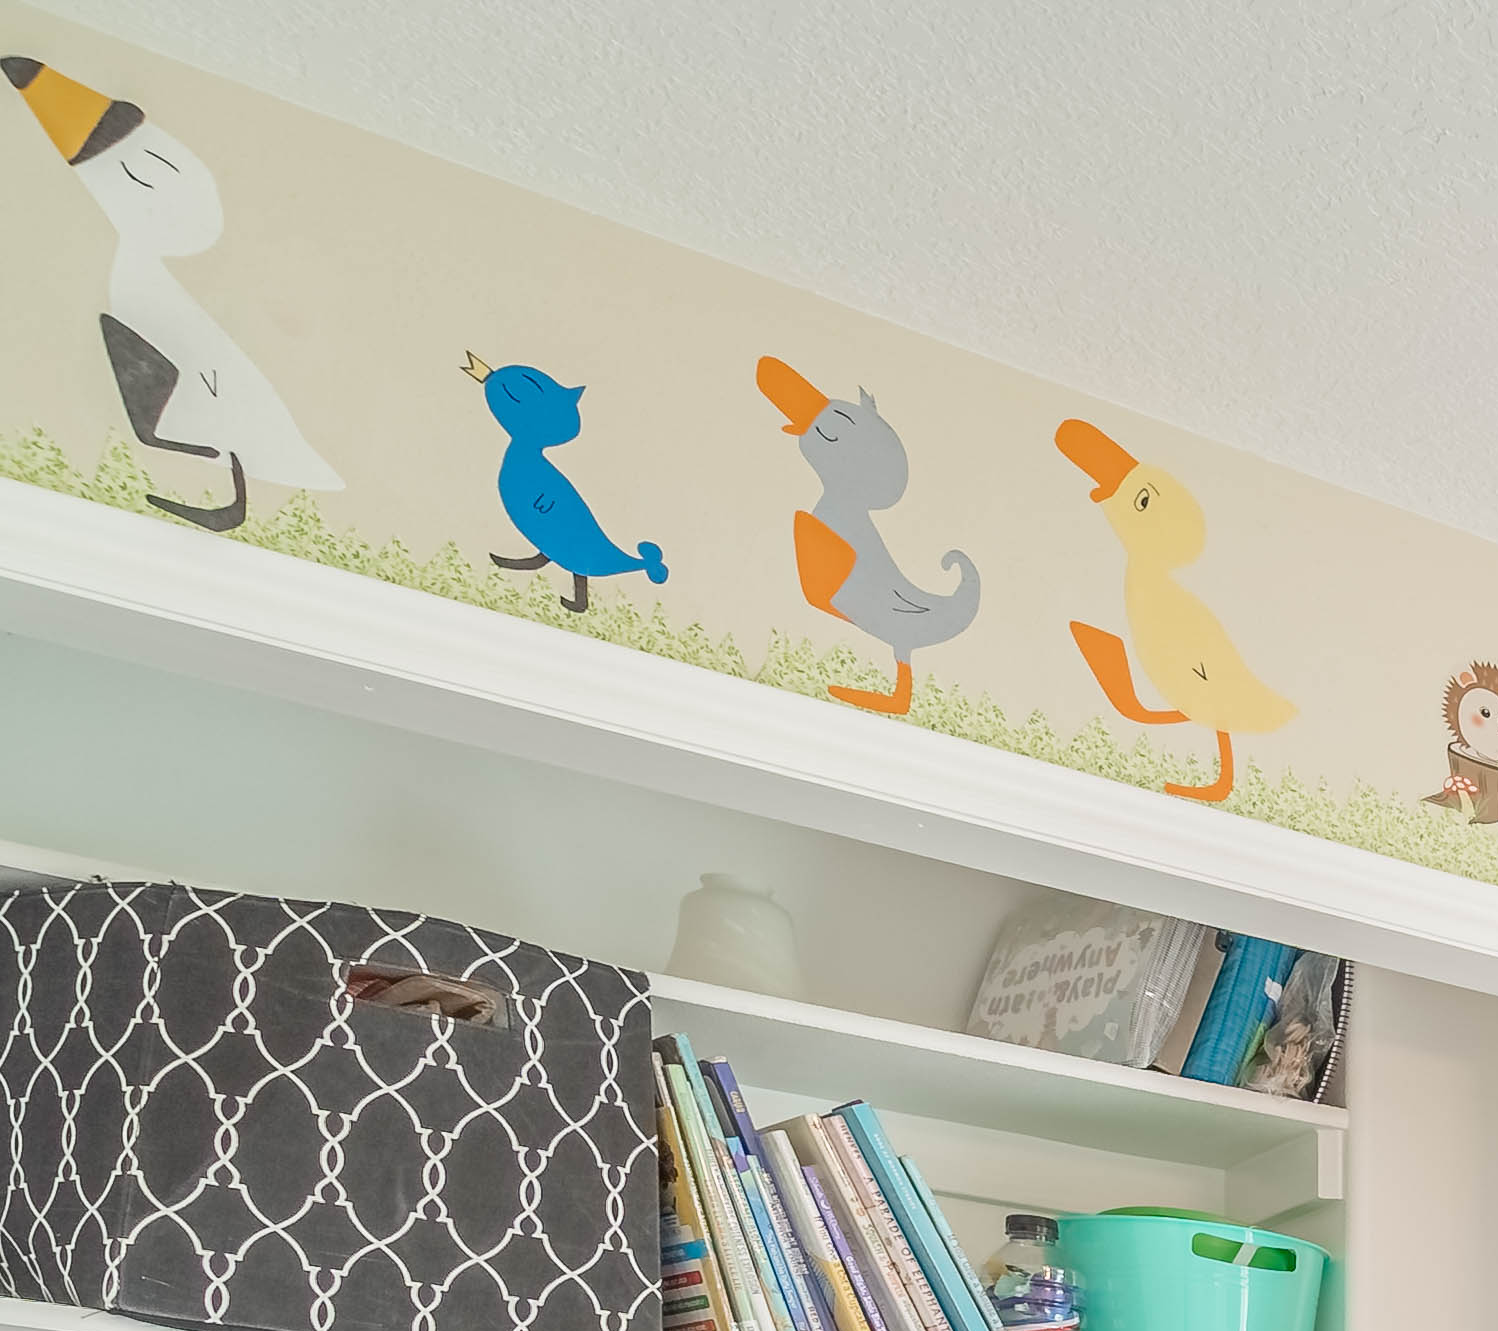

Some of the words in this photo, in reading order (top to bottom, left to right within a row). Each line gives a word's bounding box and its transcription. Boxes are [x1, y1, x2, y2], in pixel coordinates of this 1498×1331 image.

[1001, 941, 1123, 990] Anywhere
[863, 1173, 875, 1185] A
[871, 1189, 903, 1242] PARADE
[900, 1246, 916, 1266] OF
